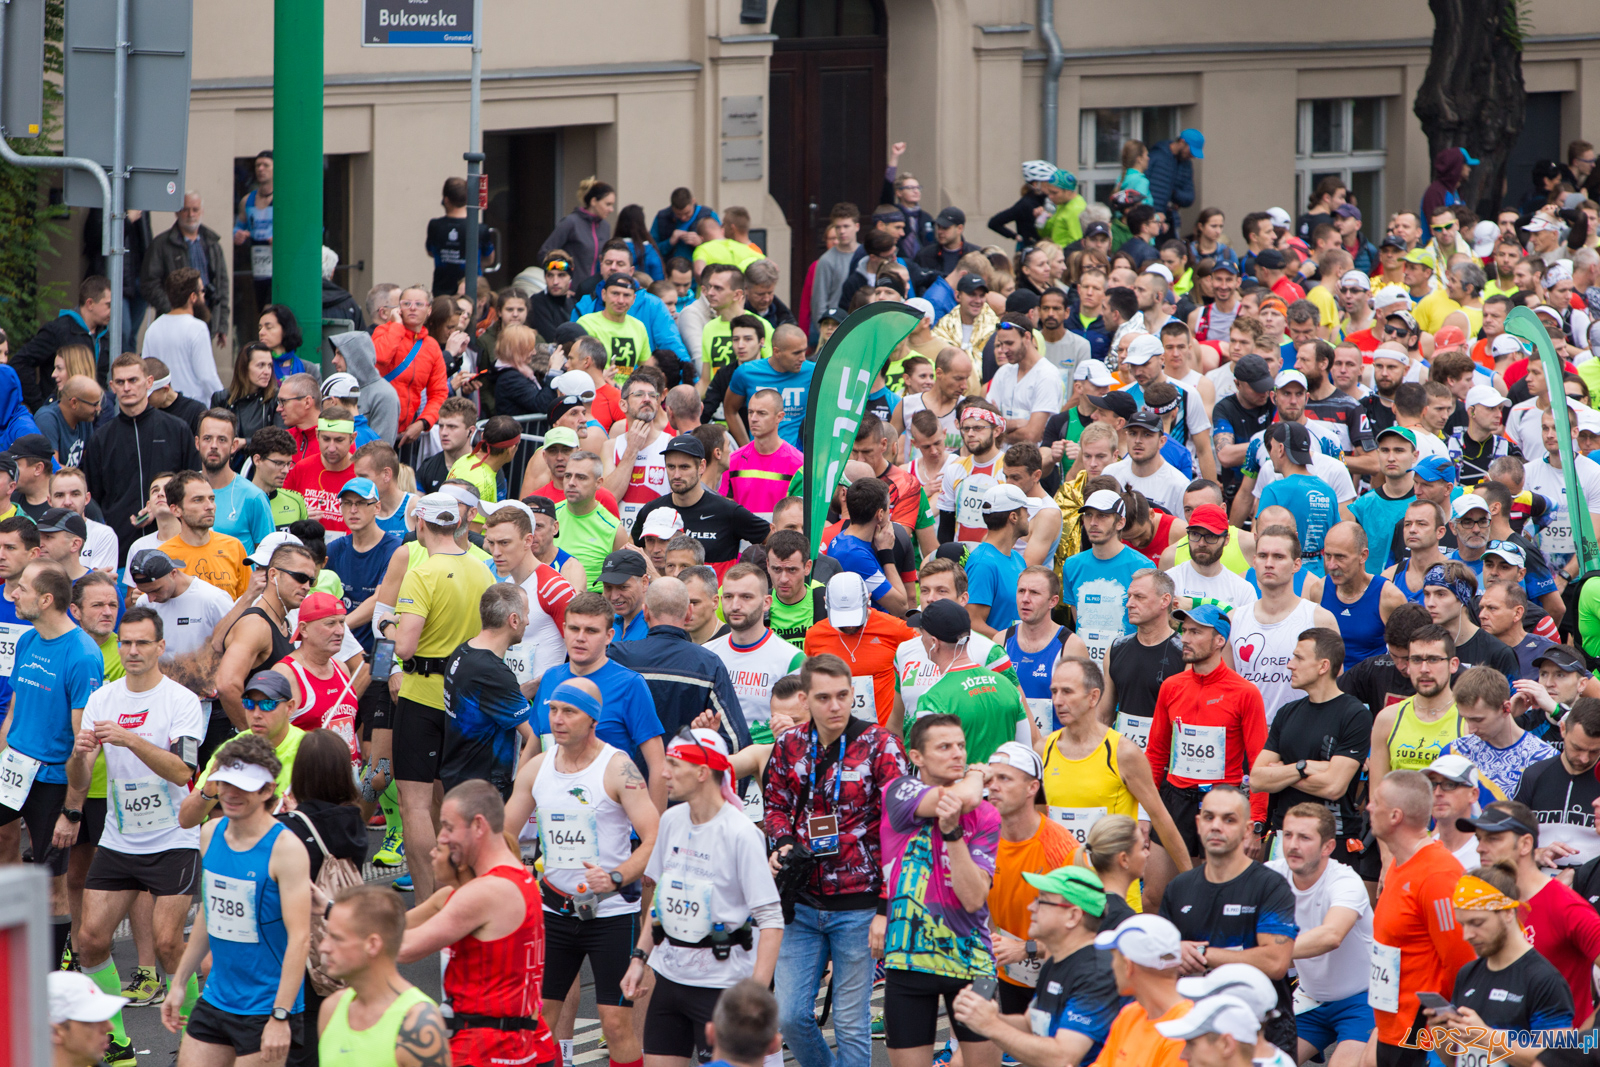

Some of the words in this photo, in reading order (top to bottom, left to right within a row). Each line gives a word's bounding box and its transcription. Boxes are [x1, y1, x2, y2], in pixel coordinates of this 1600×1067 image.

[379, 9, 457, 26] Bukowska
[305, 489, 338, 501] DRUŻYN
[1310, 495, 1330, 503] Enea
[305, 498, 342, 512] SZPIK
[1545, 527, 1572, 538] 3957
[961, 676, 997, 691] JÓZEK
[969, 686, 997, 697] POLSKA
[1181, 742, 1215, 758] 3568
[1396, 750, 1439, 761] SUDECK
[125, 794, 162, 812] 4693
[549, 830, 586, 844] 1644
[211, 896, 244, 917] 7388
[666, 897, 699, 917] 3679
